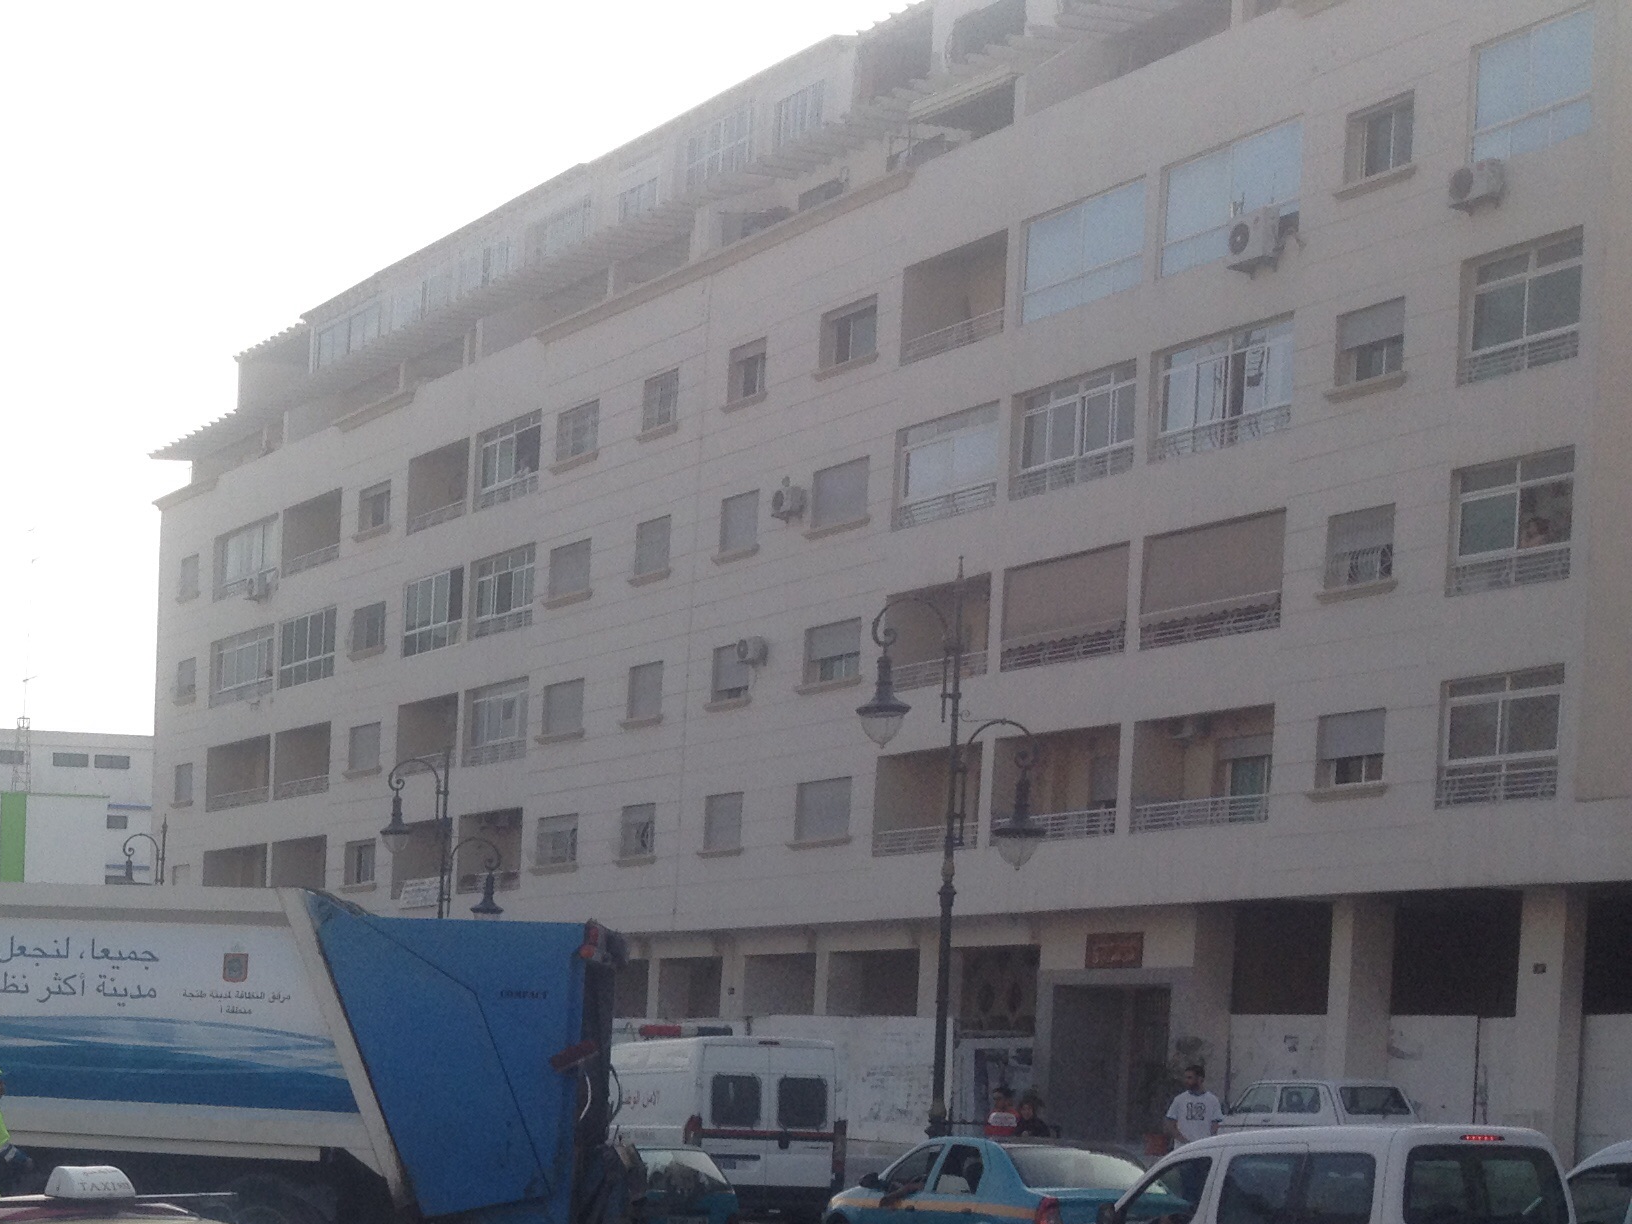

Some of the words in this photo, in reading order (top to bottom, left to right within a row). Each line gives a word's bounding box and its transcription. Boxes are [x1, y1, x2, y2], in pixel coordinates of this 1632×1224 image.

[36, 972, 86, 1003] أكثر
[95, 974, 158, 1007] مدينة
[182, 989, 207, 1001] طنجة
[1186, 1102, 1206, 1121] 12
[79, 1182, 117, 1192] TAXI
